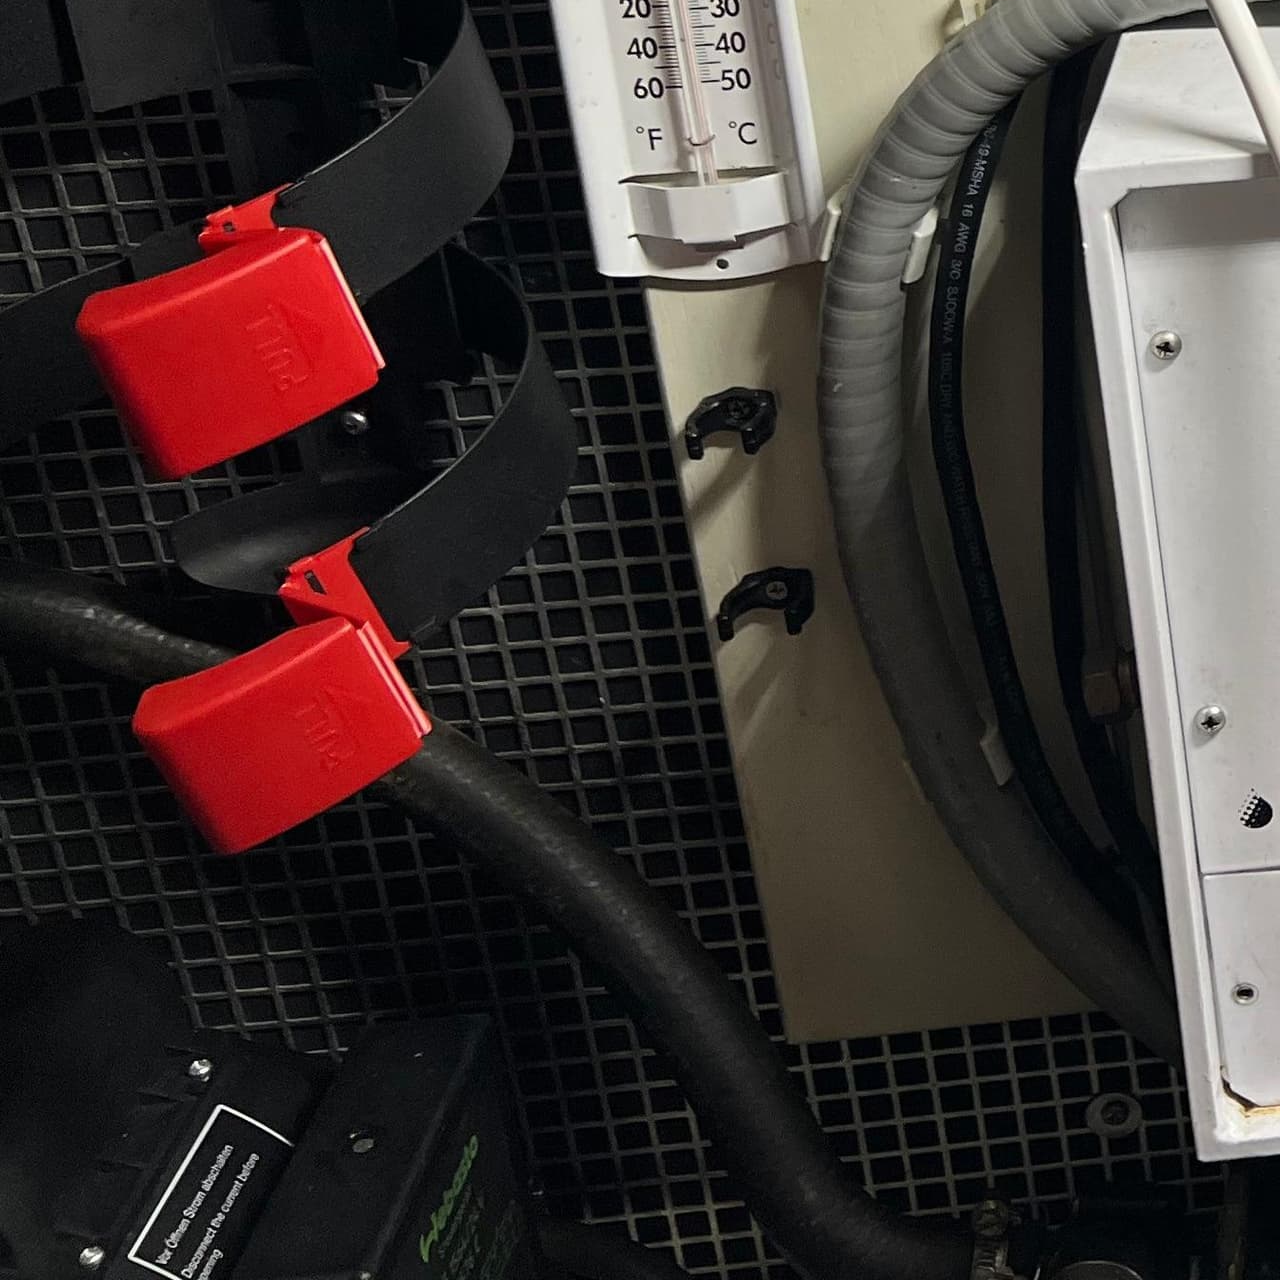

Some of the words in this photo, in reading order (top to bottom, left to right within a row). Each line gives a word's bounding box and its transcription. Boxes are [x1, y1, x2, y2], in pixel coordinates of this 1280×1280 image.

[627, 37, 658, 60] 40
[715, 31, 746, 55] 40
[633, 77, 664, 99] 60
[719, 68, 751, 91] 50
[183, 1192, 207, 1219] Strom
[201, 1144, 234, 1192] abschalten
[181, 1226, 217, 1278] Disconnect
[211, 1212, 226, 1228] the
[221, 1180, 243, 1213] current
[237, 1152, 260, 1183] before
